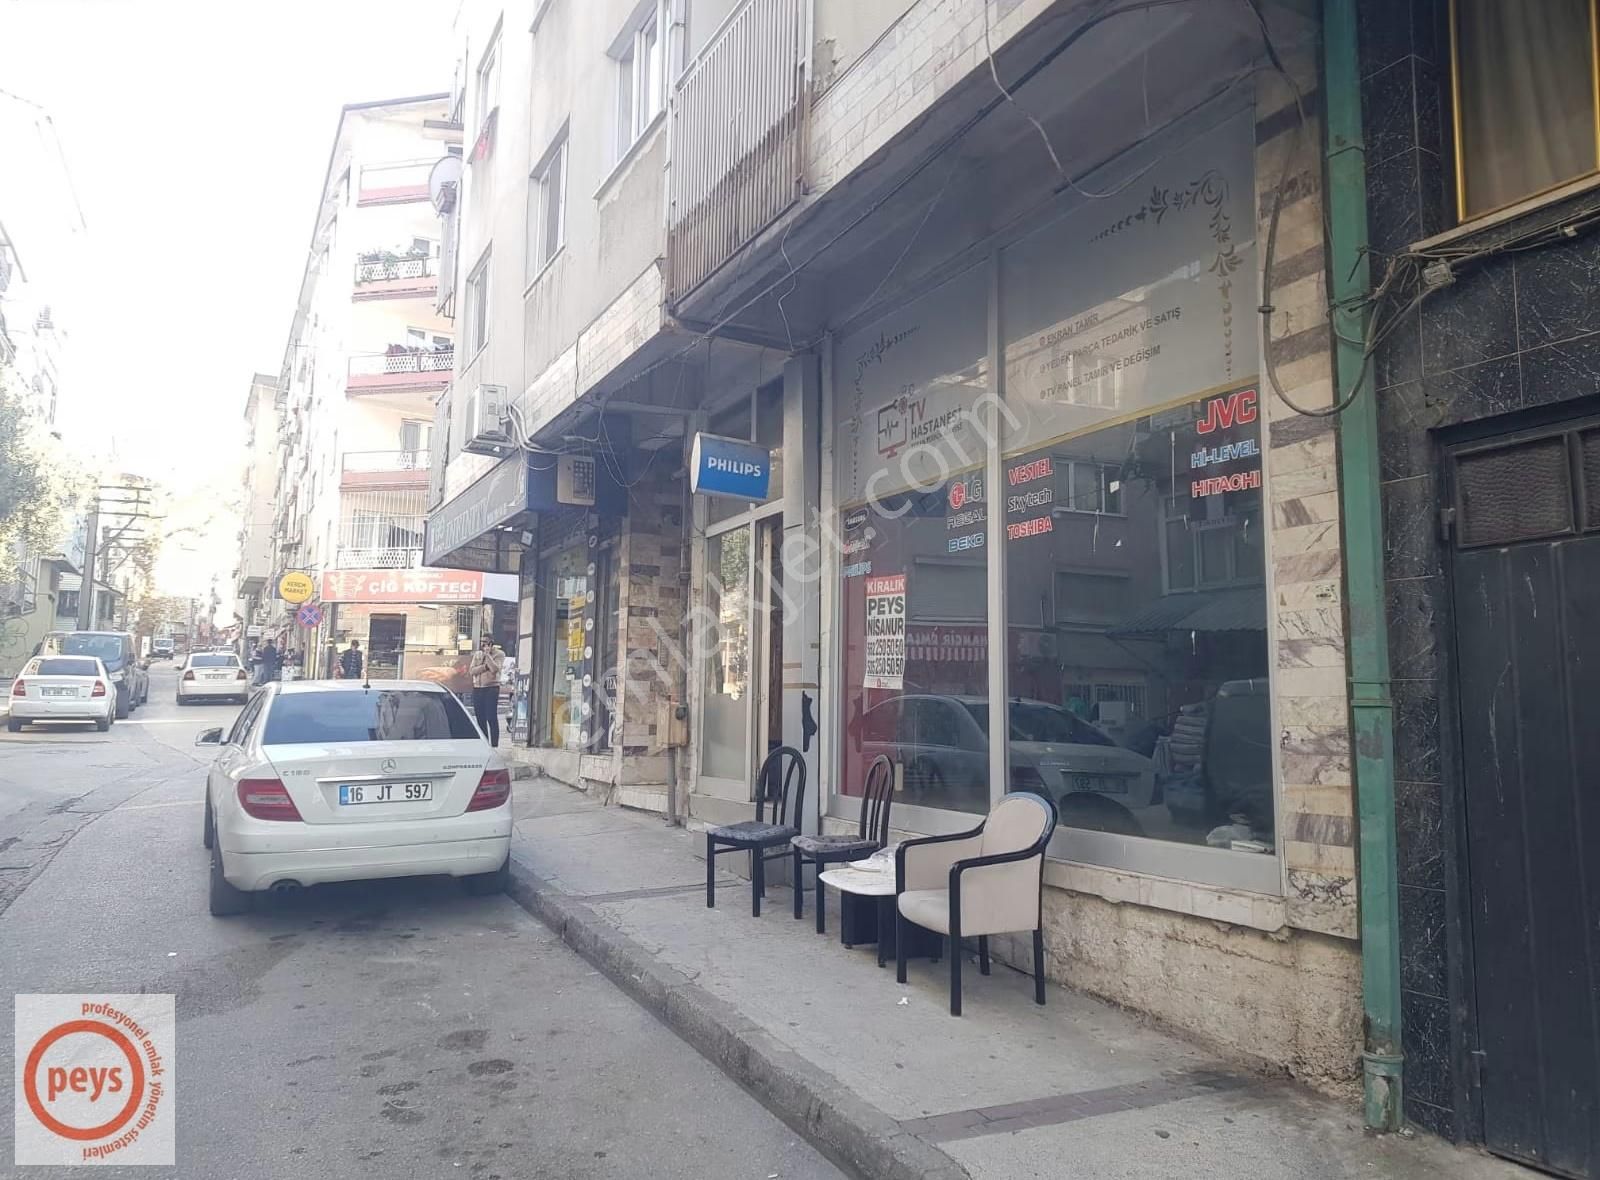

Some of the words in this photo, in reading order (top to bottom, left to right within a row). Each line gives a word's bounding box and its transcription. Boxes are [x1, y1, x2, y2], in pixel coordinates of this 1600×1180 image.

[1140, 320, 1152, 331] VE
[1046, 386, 1056, 398] TV
[1110, 360, 1122, 372] VE
[908, 397, 927, 425] TV
[1196, 390, 1257, 434] JVC
[707, 456, 762, 477] PHILIPS
[1008, 458, 1053, 486] VESTEL
[1192, 470, 1260, 498] HITACHI
[1008, 488, 1052, 513] Skytech
[947, 508, 987, 529] REGAL
[1007, 516, 1053, 540] TOSHIBA
[948, 532, 985, 553] BEKO
[868, 596, 904, 616] PEYS
[868, 616, 904, 636] NİSANUR
[351, 787, 363, 802] 16
[377, 785, 392, 800] JT
[405, 784, 429, 799] 597
